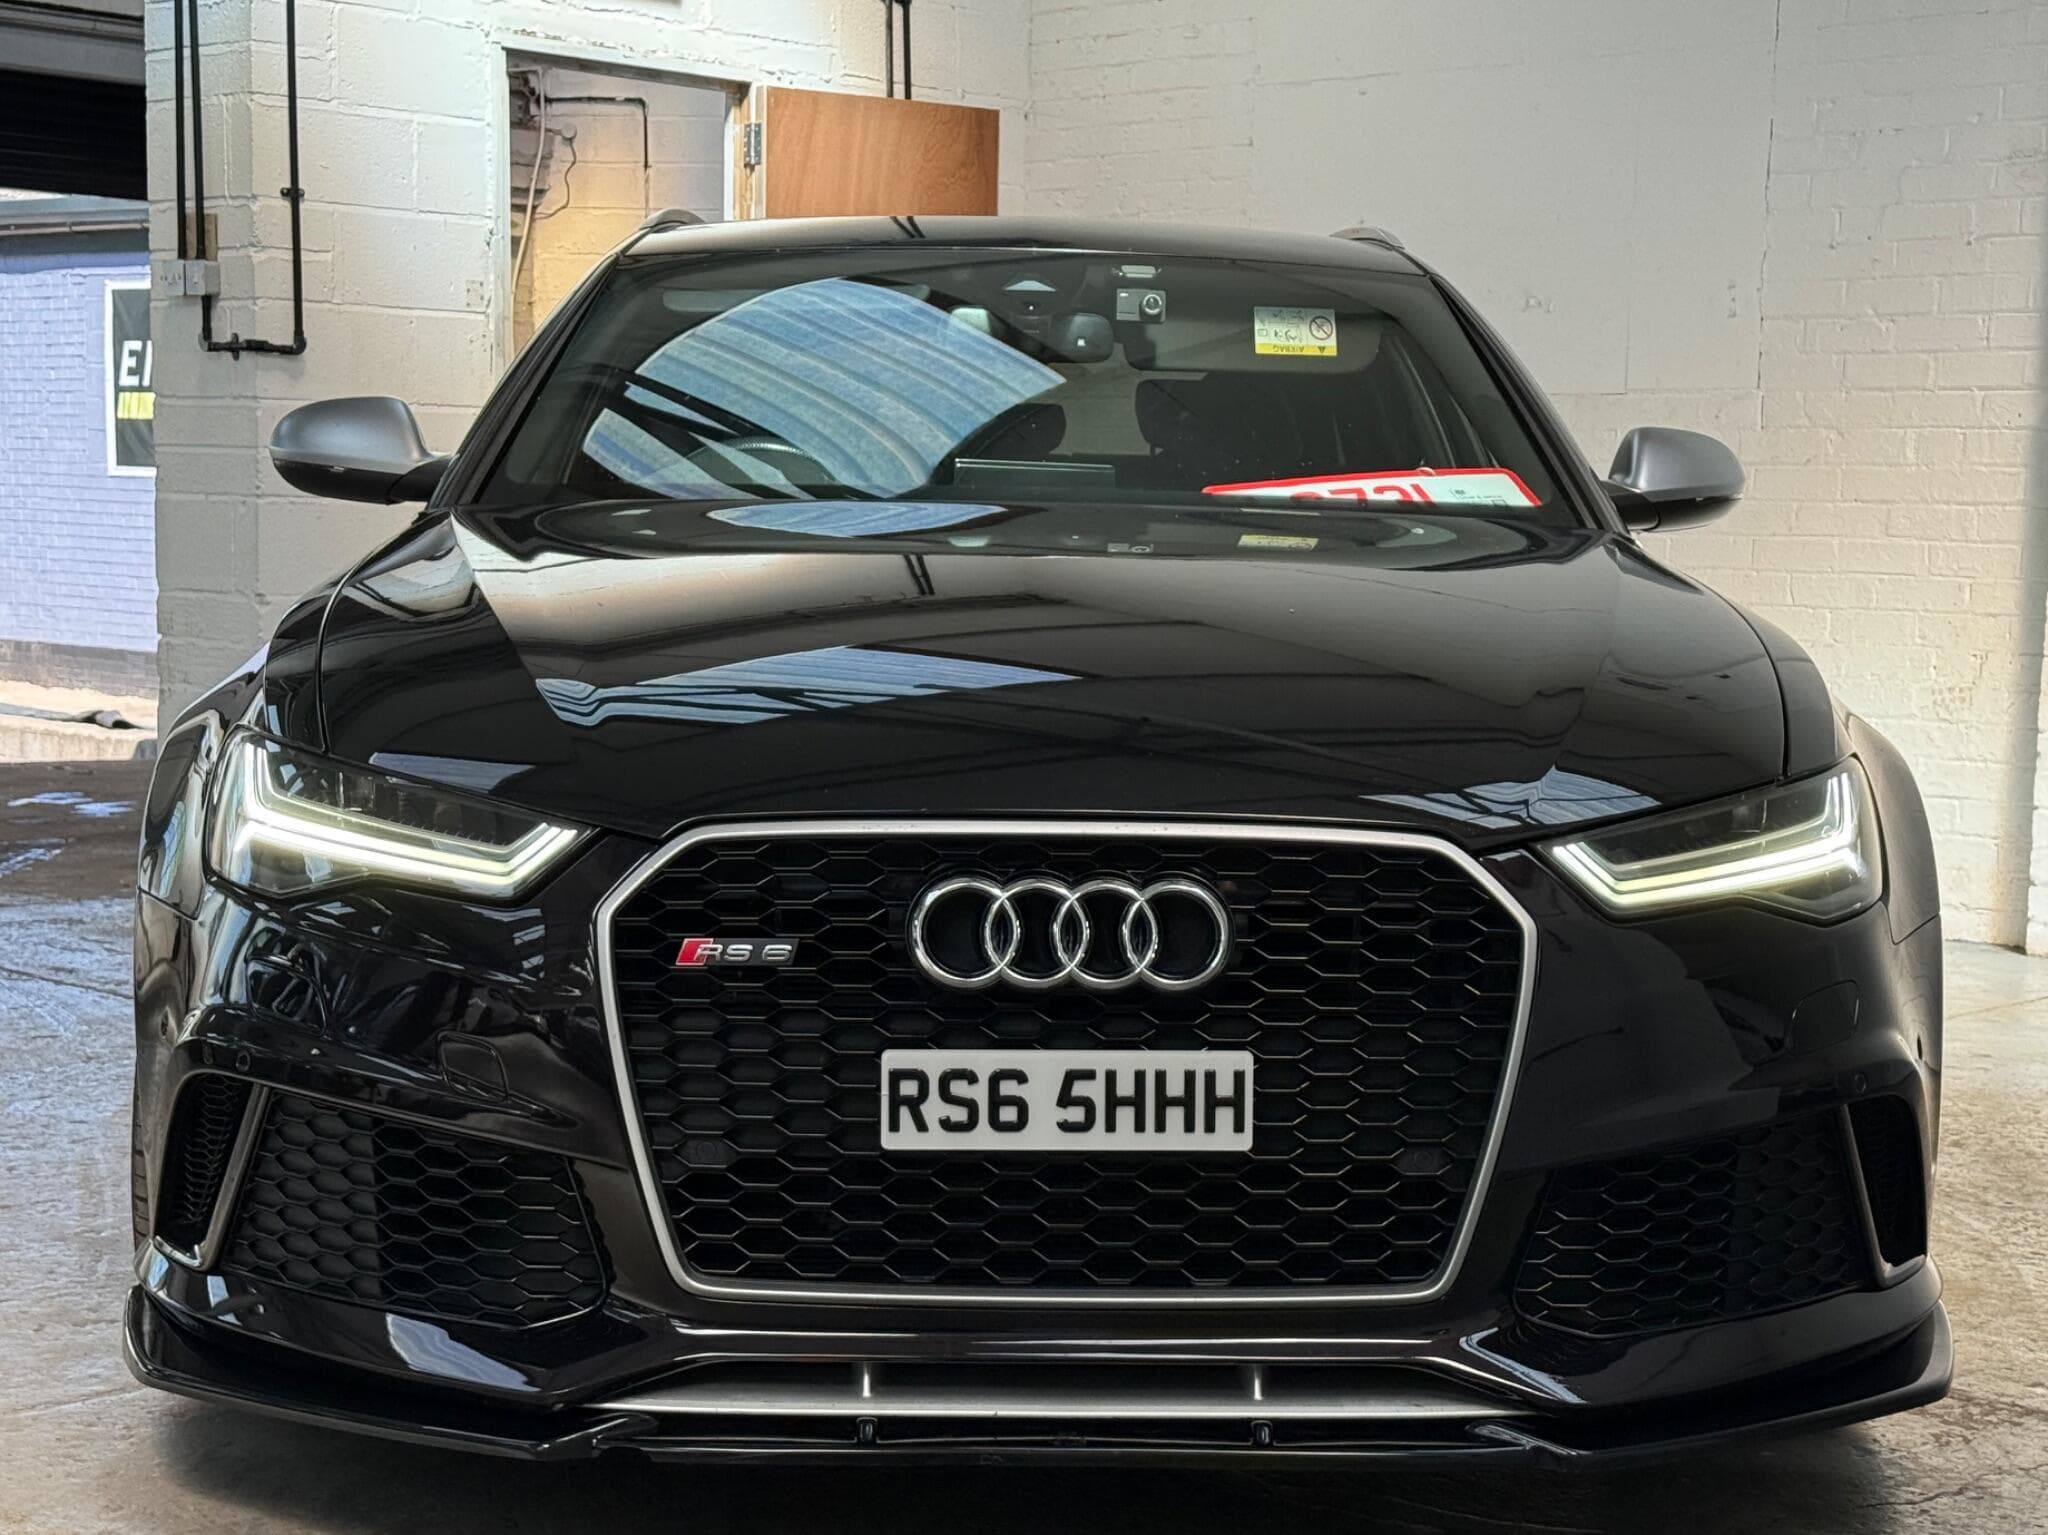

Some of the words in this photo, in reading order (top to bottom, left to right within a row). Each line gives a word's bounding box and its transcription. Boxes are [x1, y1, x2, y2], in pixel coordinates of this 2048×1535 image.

[1272, 345, 1305, 353] AIRBAG
[693, 944, 753, 961] RS
[762, 944, 793, 961] 6
[888, 1068, 1029, 1133] RS6
[1055, 1068, 1245, 1133] 5HHH
